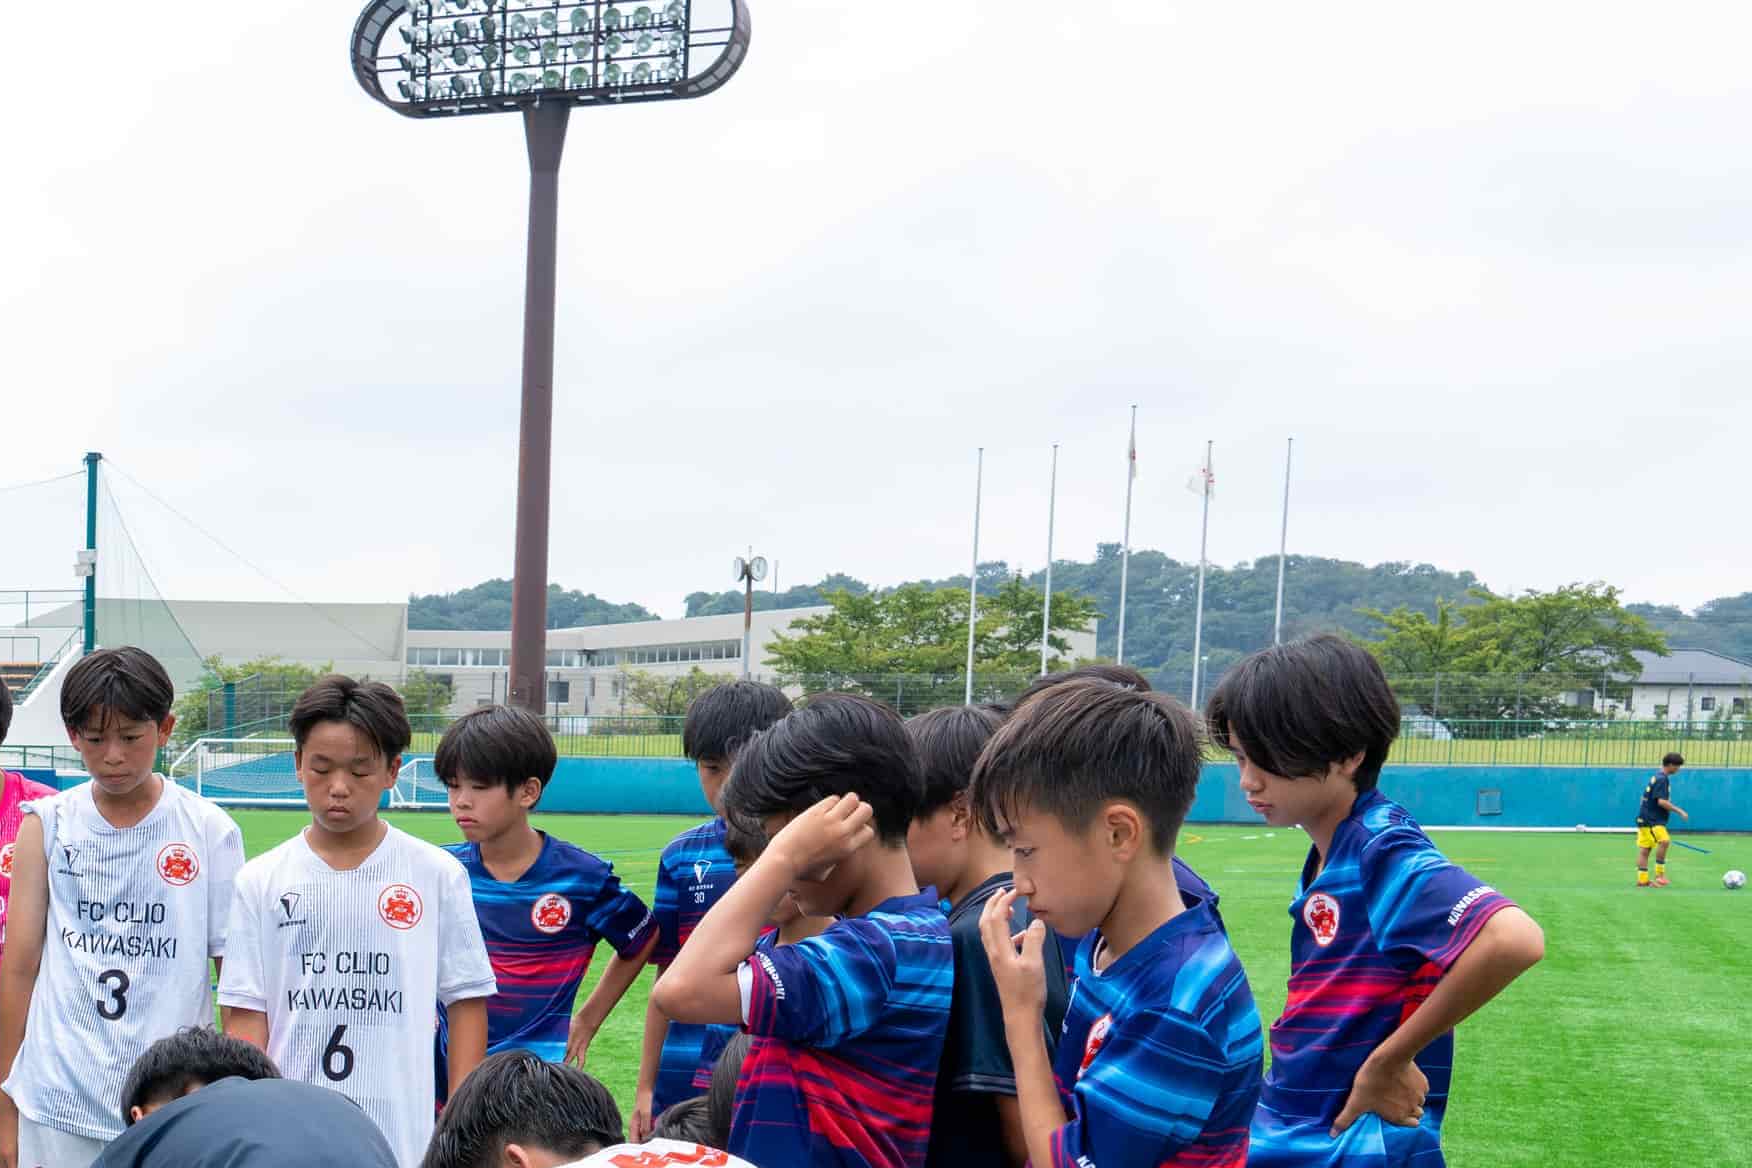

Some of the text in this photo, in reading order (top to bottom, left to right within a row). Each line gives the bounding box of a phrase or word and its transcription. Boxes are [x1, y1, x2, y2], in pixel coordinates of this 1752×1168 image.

[78, 900, 166, 924] FC CLIO
[1447, 885, 1497, 927] KAWASA
[62, 926, 177, 959] KAWASAKI
[301, 951, 390, 976] FC CLIO
[96, 968, 130, 1021] 3
[287, 987, 403, 1014] KAWASAKI
[322, 1024, 354, 1082] 6
